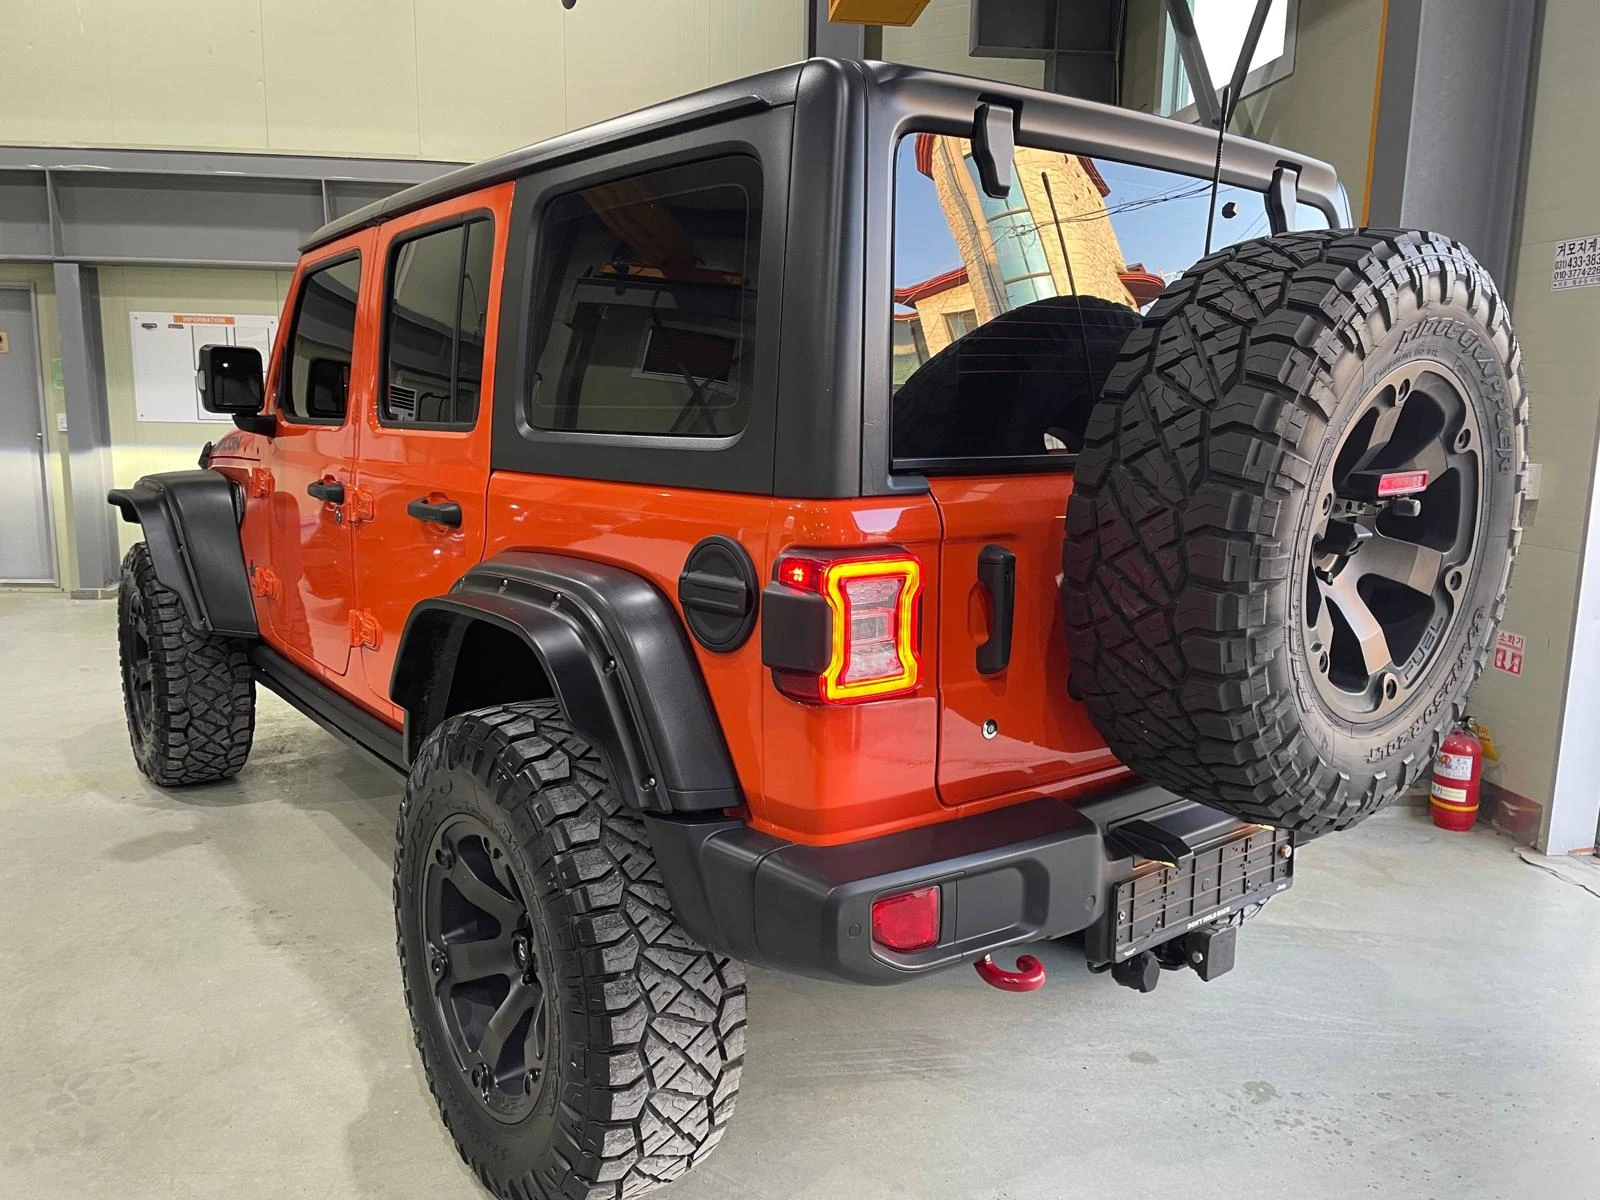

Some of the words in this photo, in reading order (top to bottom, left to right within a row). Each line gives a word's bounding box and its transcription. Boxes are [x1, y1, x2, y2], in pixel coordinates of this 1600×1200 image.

[1557, 238, 1600, 257] 거모지게
[182, 316, 225, 325] INFORMATION
[1403, 617, 1444, 681] FUEL
[1499, 632, 1524, 649] 소화기
